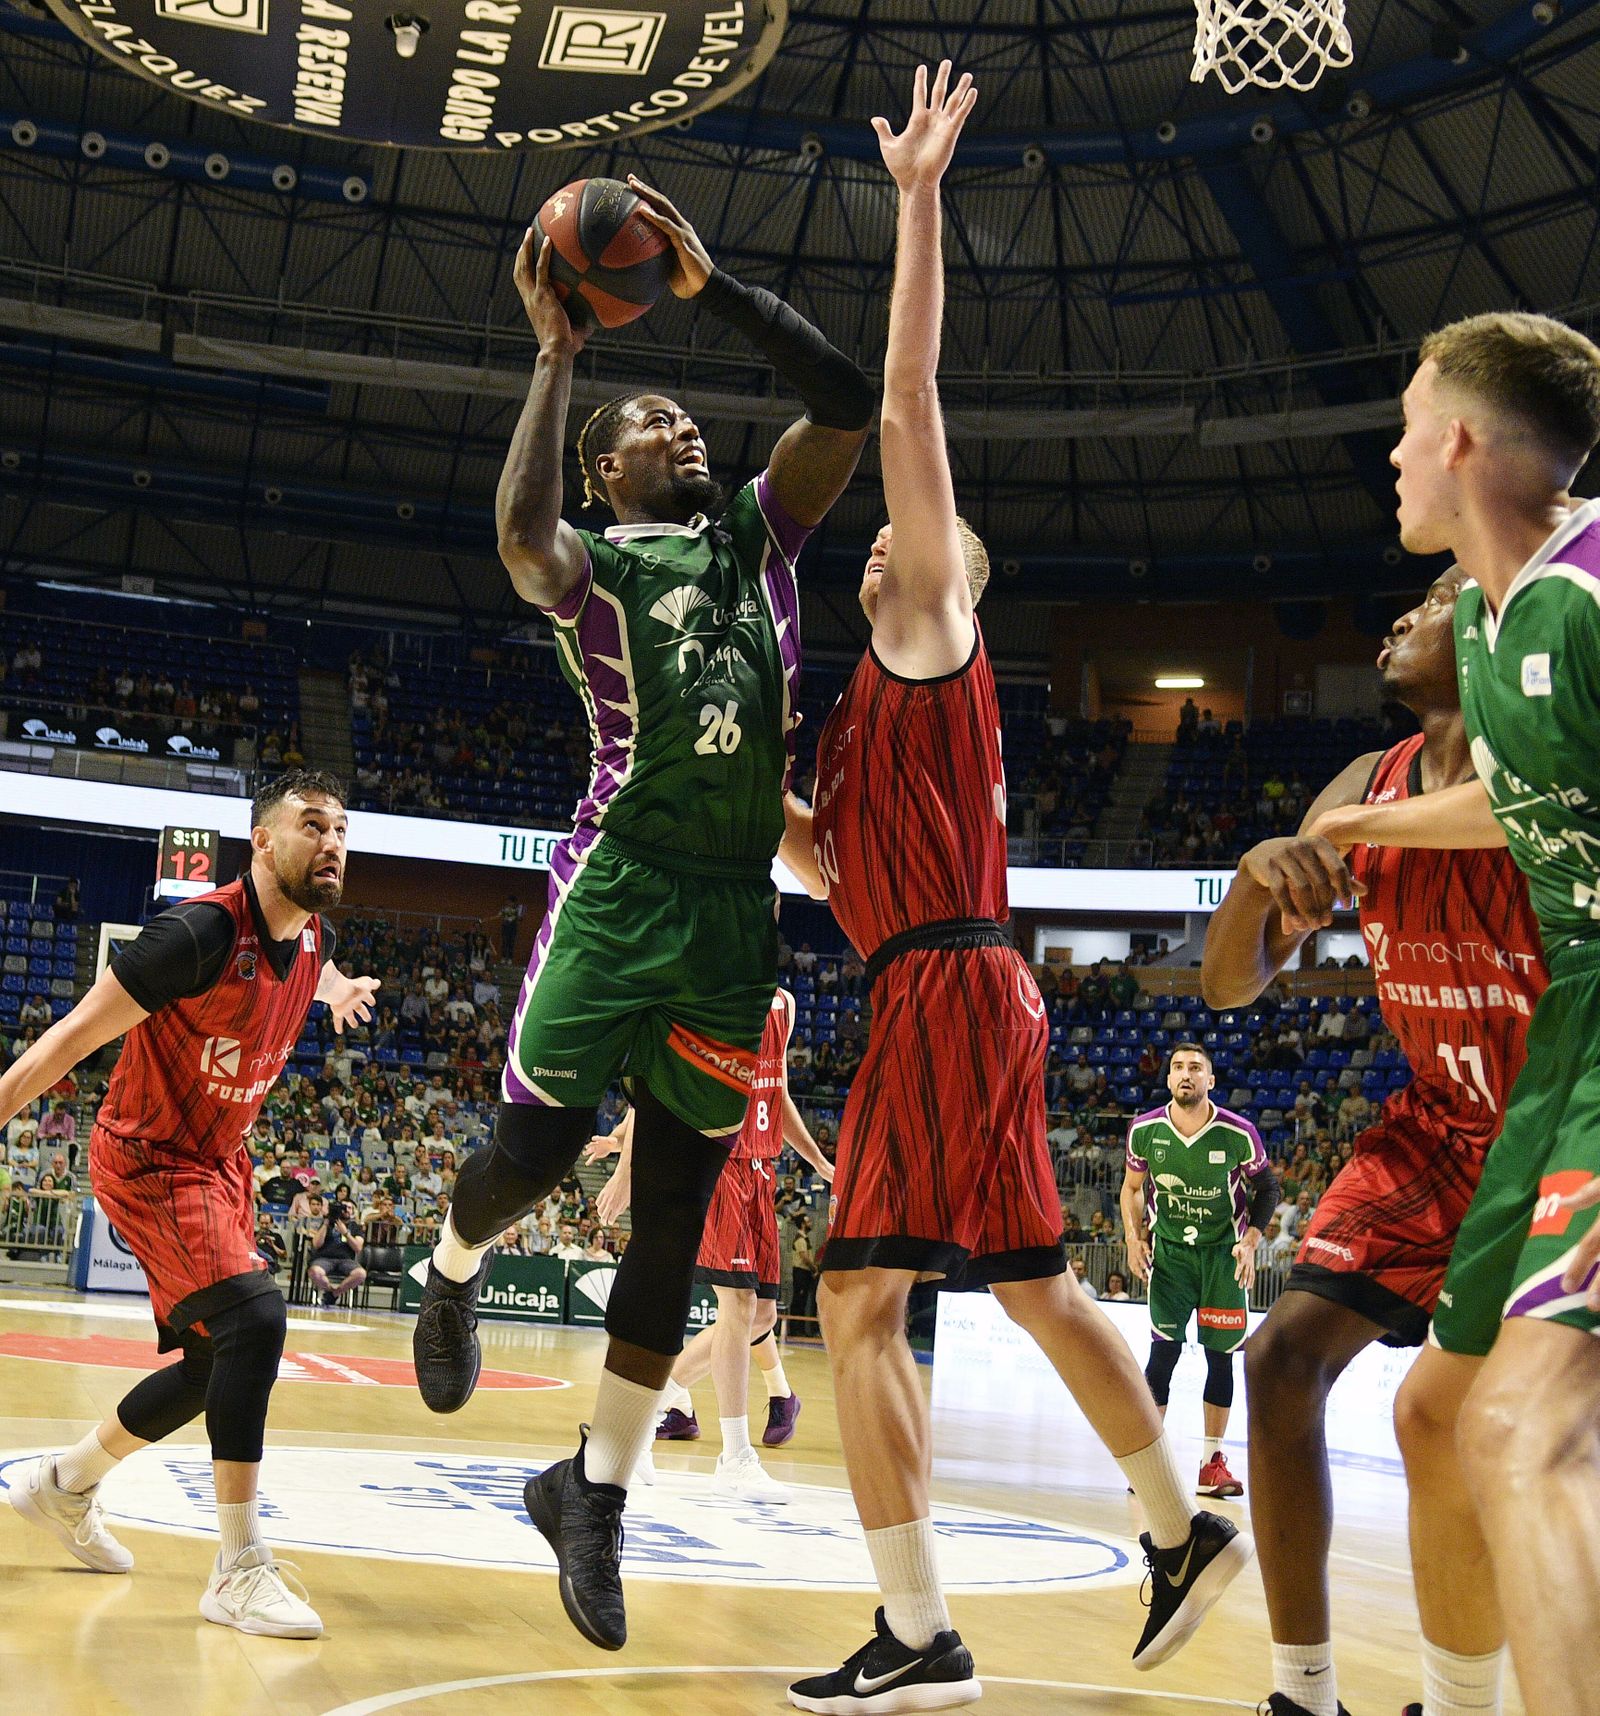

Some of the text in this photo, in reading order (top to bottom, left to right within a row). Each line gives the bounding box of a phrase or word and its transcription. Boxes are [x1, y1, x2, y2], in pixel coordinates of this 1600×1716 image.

[76, 0, 267, 113] LAZQUEZ
[456, 30, 511, 65] LA
[292, 23, 350, 126] RESERVA
[440, 68, 500, 142] GRUPO
[694, 700, 741, 755] 26
[173, 830, 210, 848] 3:11
[499, 833, 526, 862] TU
[170, 850, 210, 882] 12
[1194, 878, 1223, 905] TU
[532, 1066, 577, 1079] SPALDING
[757, 1100, 769, 1132] 8
[1184, 1186, 1221, 1197] Unicaja
[1183, 1225, 1198, 1246] 2
[93, 1258, 132, 1271] Málaga
[478, 1284, 559, 1313] Unicaja
[1201, 1313, 1242, 1325] worten
